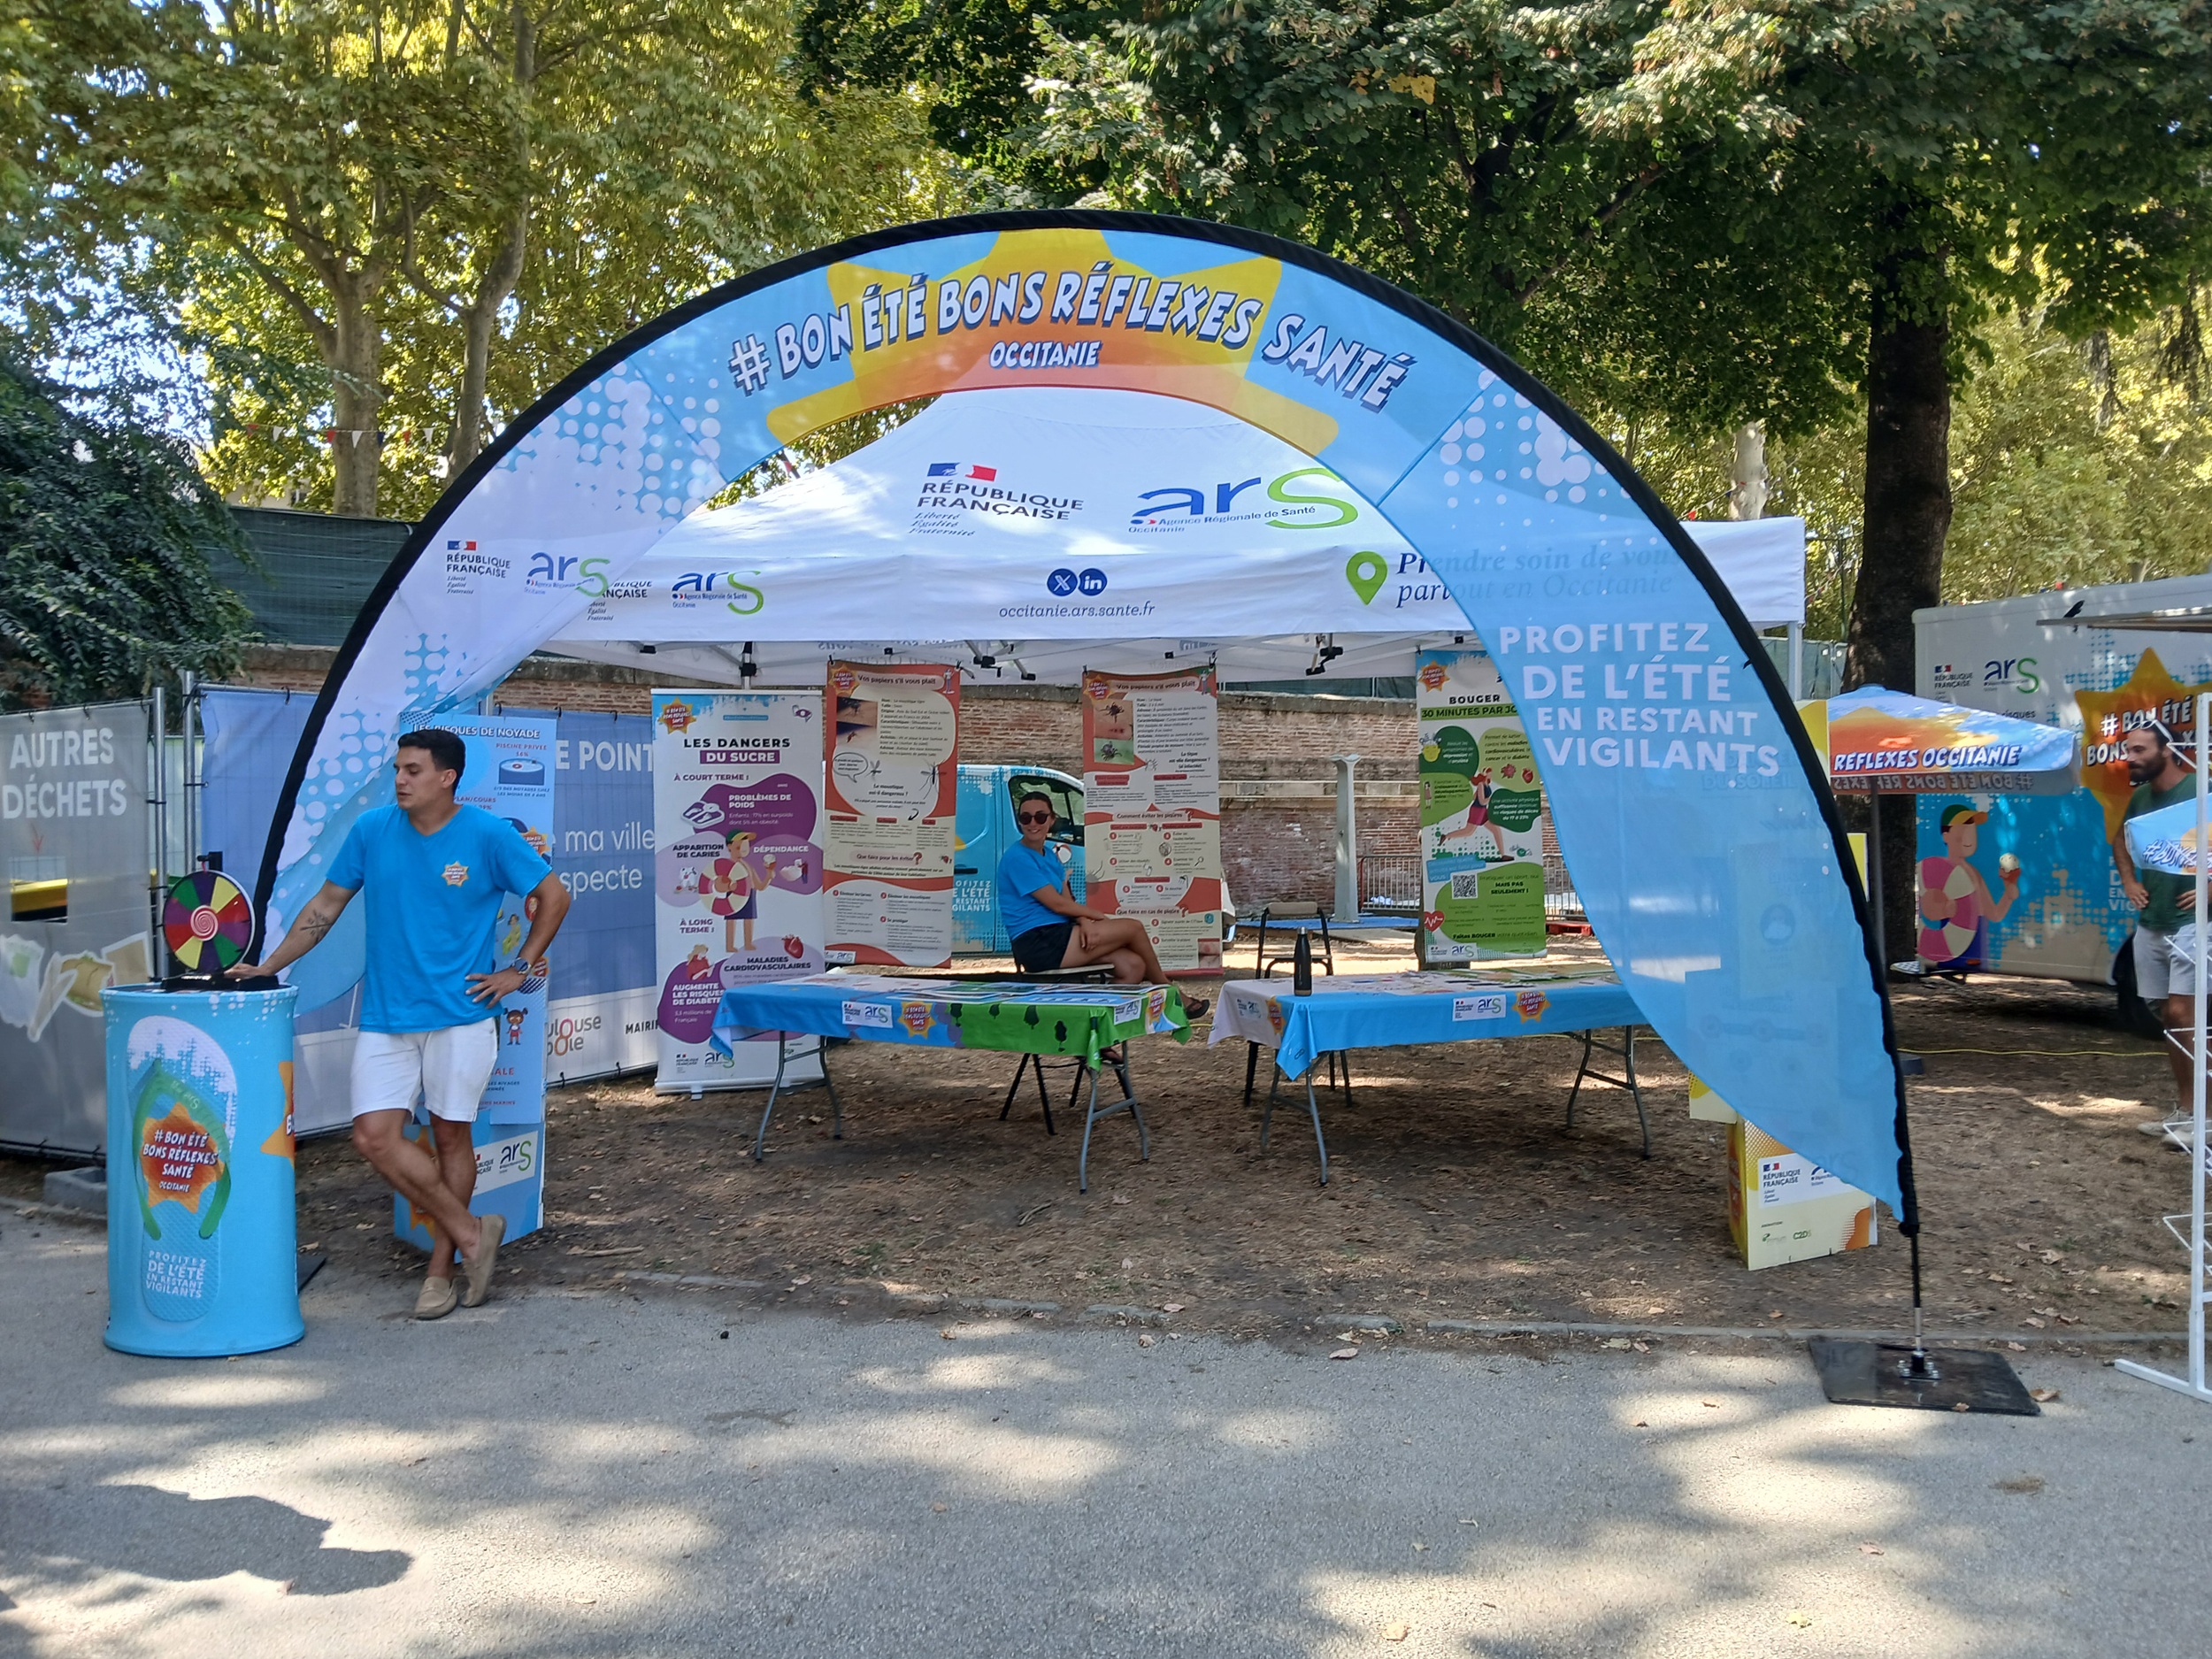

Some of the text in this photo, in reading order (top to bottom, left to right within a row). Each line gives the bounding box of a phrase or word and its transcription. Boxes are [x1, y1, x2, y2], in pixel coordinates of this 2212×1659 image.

[728, 260, 1418, 414] # BON ÉTÉ BONS RÉFLEXES SANTÉ
[988, 340, 1102, 369] OCCITANIE
[921, 480, 1084, 511] RÉPUBLIQUE
[914, 511, 961, 520] Liberté
[917, 495, 1071, 520] FRANÇAISE
[1158, 505, 1317, 526] Agence Régionale de Santé
[446, 552, 511, 570] RÉPUBLIQUE
[446, 564, 507, 579] FRANÇAISE
[998, 600, 1156, 618] occitanie.ars.sante.fr
[1500, 622, 1710, 655] PROFITEZ
[1522, 653, 1732, 703] DE L'ÉTÉ
[1933, 680, 1972, 690] FRANÇAISE
[1448, 694, 1502, 705] BOUGER
[1421, 706, 1503, 718] 30 MINUTES PAR
[2162, 695, 2194, 726] ÉTÉ
[1537, 706, 1758, 738] EN RESTANT
[480, 727, 495, 736] DE
[496, 728, 541, 740] NOYADE
[9, 726, 115, 770] AUTRES
[683, 736, 792, 749] LES DANGERS
[579, 741, 654, 772] POINT
[705, 750, 776, 763] DU SUCRE
[1542, 736, 1780, 777] VIGILANTS
[1833, 744, 2025, 772] RÉFLEXES OCCITANIE
[673, 772, 681, 782] À
[2, 772, 127, 819] DÉCHETS
[728, 792, 793, 802] PROBLÈMES DE
[565, 820, 656, 854] ma ville
[672, 843, 725, 852] APPARITION
[676, 849, 721, 859] DE CARIES
[752, 843, 810, 854] DÉPENDANCE
[562, 864, 643, 901] specte
[952, 903, 991, 912] GILANTS
[679, 917, 714, 926] À LONG
[723, 962, 812, 973] CARDIOVASCULAIRES
[746, 956, 790, 964] MALADIES
[672, 982, 720, 992] AUGMENTE
[672, 997, 686, 1006] DE
[165, 1131, 186, 1146] BON
[187, 1132, 211, 1148] ÉTÉ
[142, 1143, 219, 1166] BONS RÉFLEXES
[162, 1163, 195, 1179] SANTÉ
[1763, 1168, 1801, 1181] RÉPUBLIQUE
[158, 1180, 191, 1194] OCCITANIE
[1763, 1176, 1800, 1188] FRANÇAISE
[149, 1249, 207, 1266] PROFITEZ
[148, 1259, 165, 1274] DE
[145, 1279, 203, 1299] VIGILANTS
[146, 1272, 204, 1290] EN RESTANT
